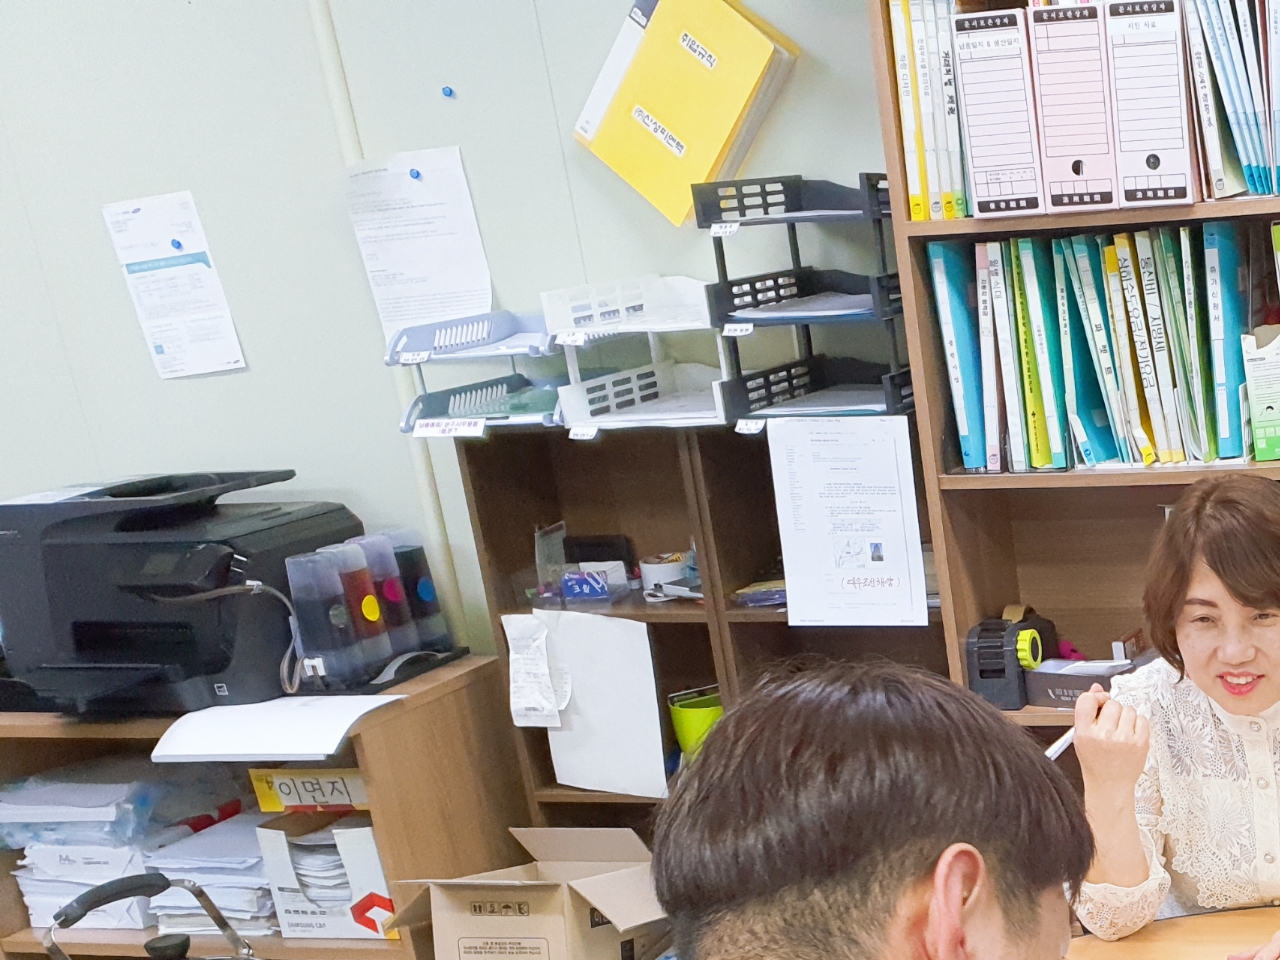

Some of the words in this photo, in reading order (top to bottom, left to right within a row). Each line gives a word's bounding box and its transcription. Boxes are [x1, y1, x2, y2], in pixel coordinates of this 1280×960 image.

[680, 32, 716, 68] 취업규칙
[1149, 315, 1166, 353] 지방세
[278, 776, 353, 805] 이면지
